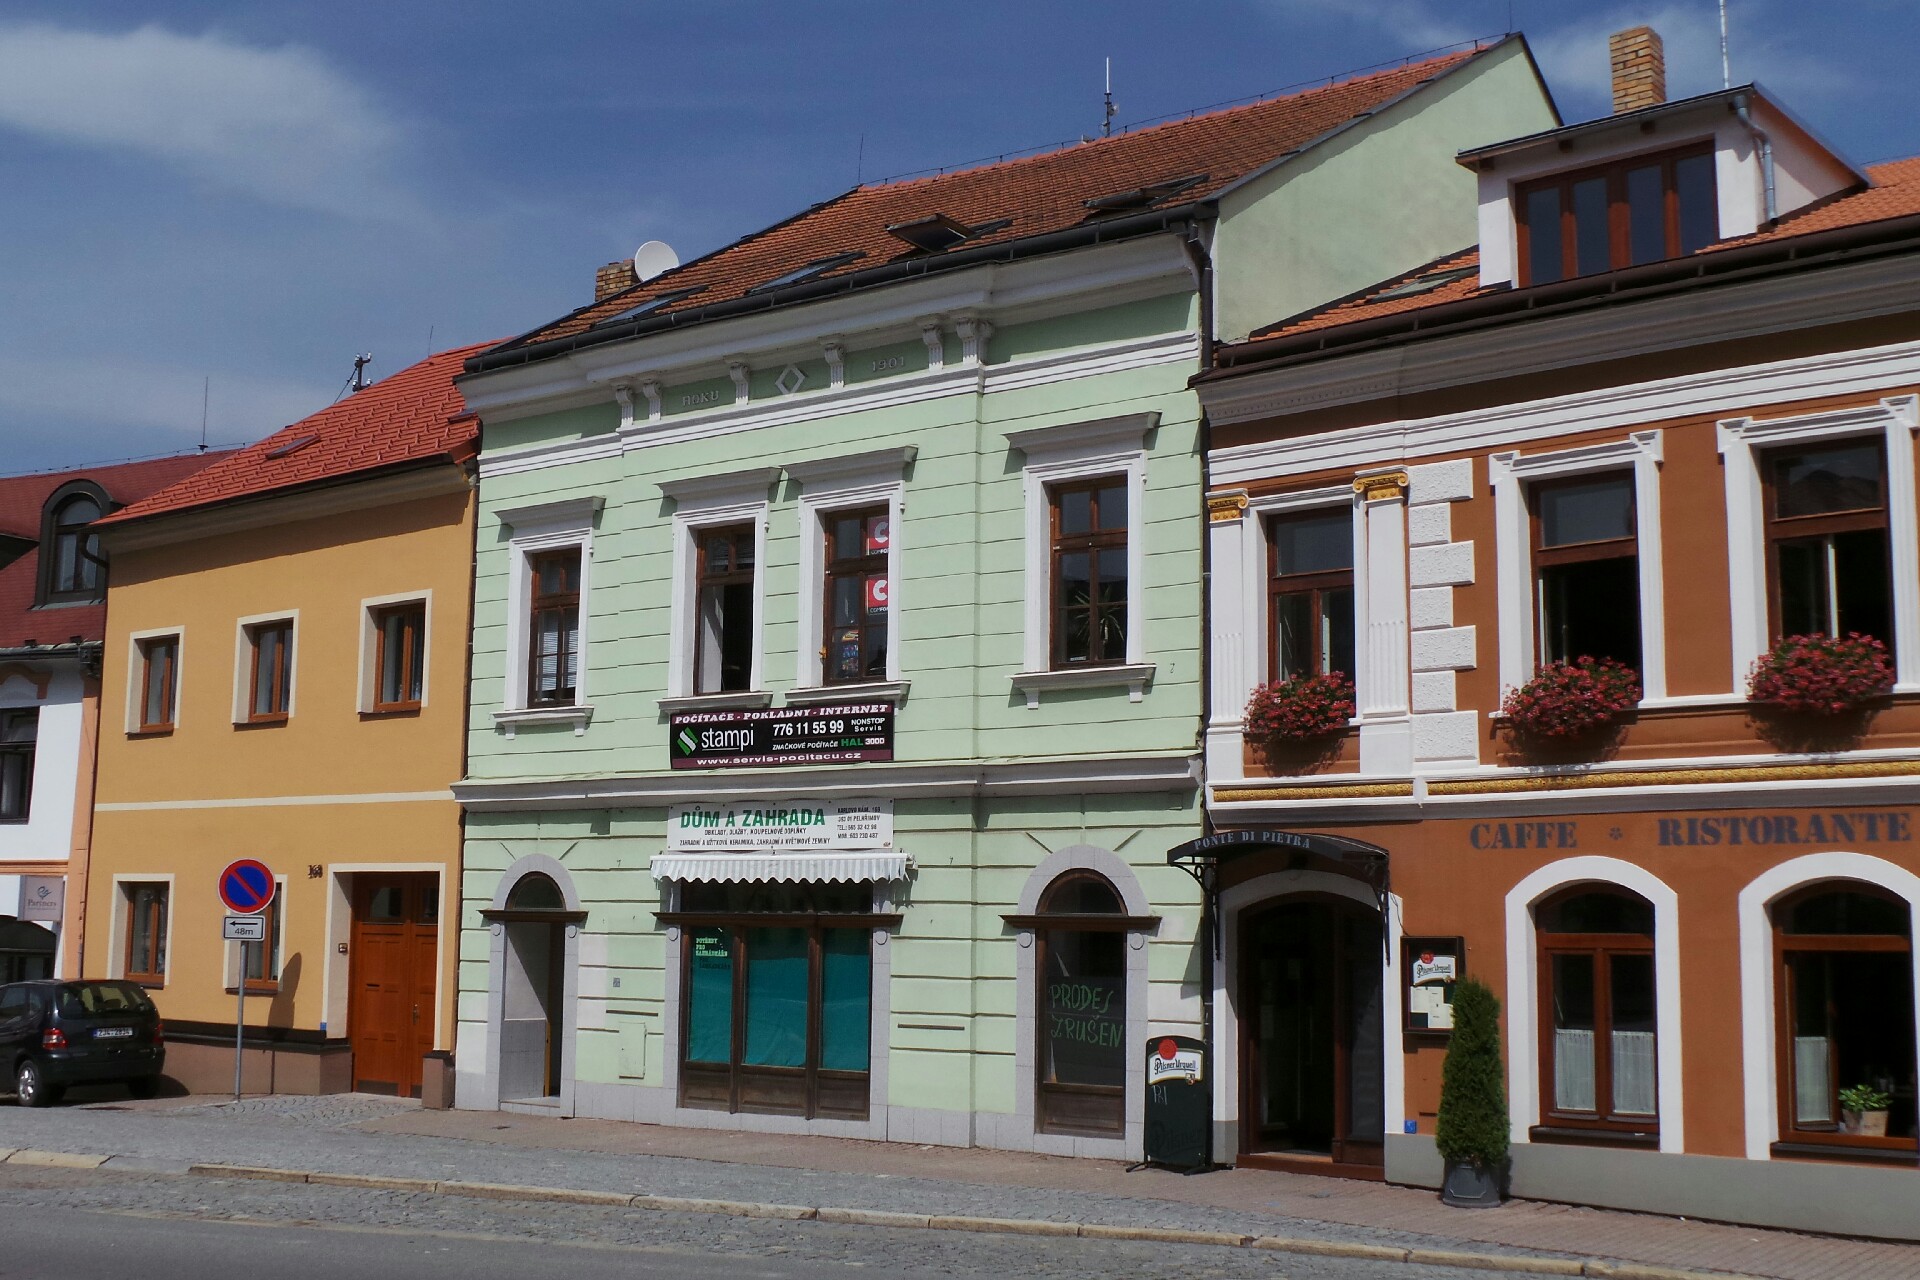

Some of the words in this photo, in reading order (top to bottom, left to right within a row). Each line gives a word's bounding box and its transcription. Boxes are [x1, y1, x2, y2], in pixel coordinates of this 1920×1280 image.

[675, 712, 734, 724] POČÍTAČE
[744, 709, 812, 720] POKLADNY
[820, 704, 888, 716] INTERNET
[701, 723, 754, 752] stampi
[772, 723, 793, 736] 776
[796, 722, 808, 735] 11
[812, 721, 826, 734] 55
[830, 720, 844, 733] 99
[772, 742, 806, 750] ZNAČKOVÉ
[807, 740, 838, 748] POČÍTAČE
[841, 738, 864, 746] HAL
[697, 752, 862, 765] www.servis-pocitacu.cz
[680, 806, 720, 828] DŮM
[725, 811, 736, 827] A
[742, 808, 826, 826] ZAHRADA
[1470, 822, 1577, 849] CAFFE
[1657, 812, 1912, 846] RISTORANTE
[1194, 832, 1234, 850] PONTE
[1242, 832, 1255, 842] DI
[1262, 832, 1310, 848] PIETRA
[1050, 1015, 1124, 1048] ZRUŠEN
[1154, 1058, 1175, 1075] Pilsner
[1175, 1059, 1196, 1072] Urquell
